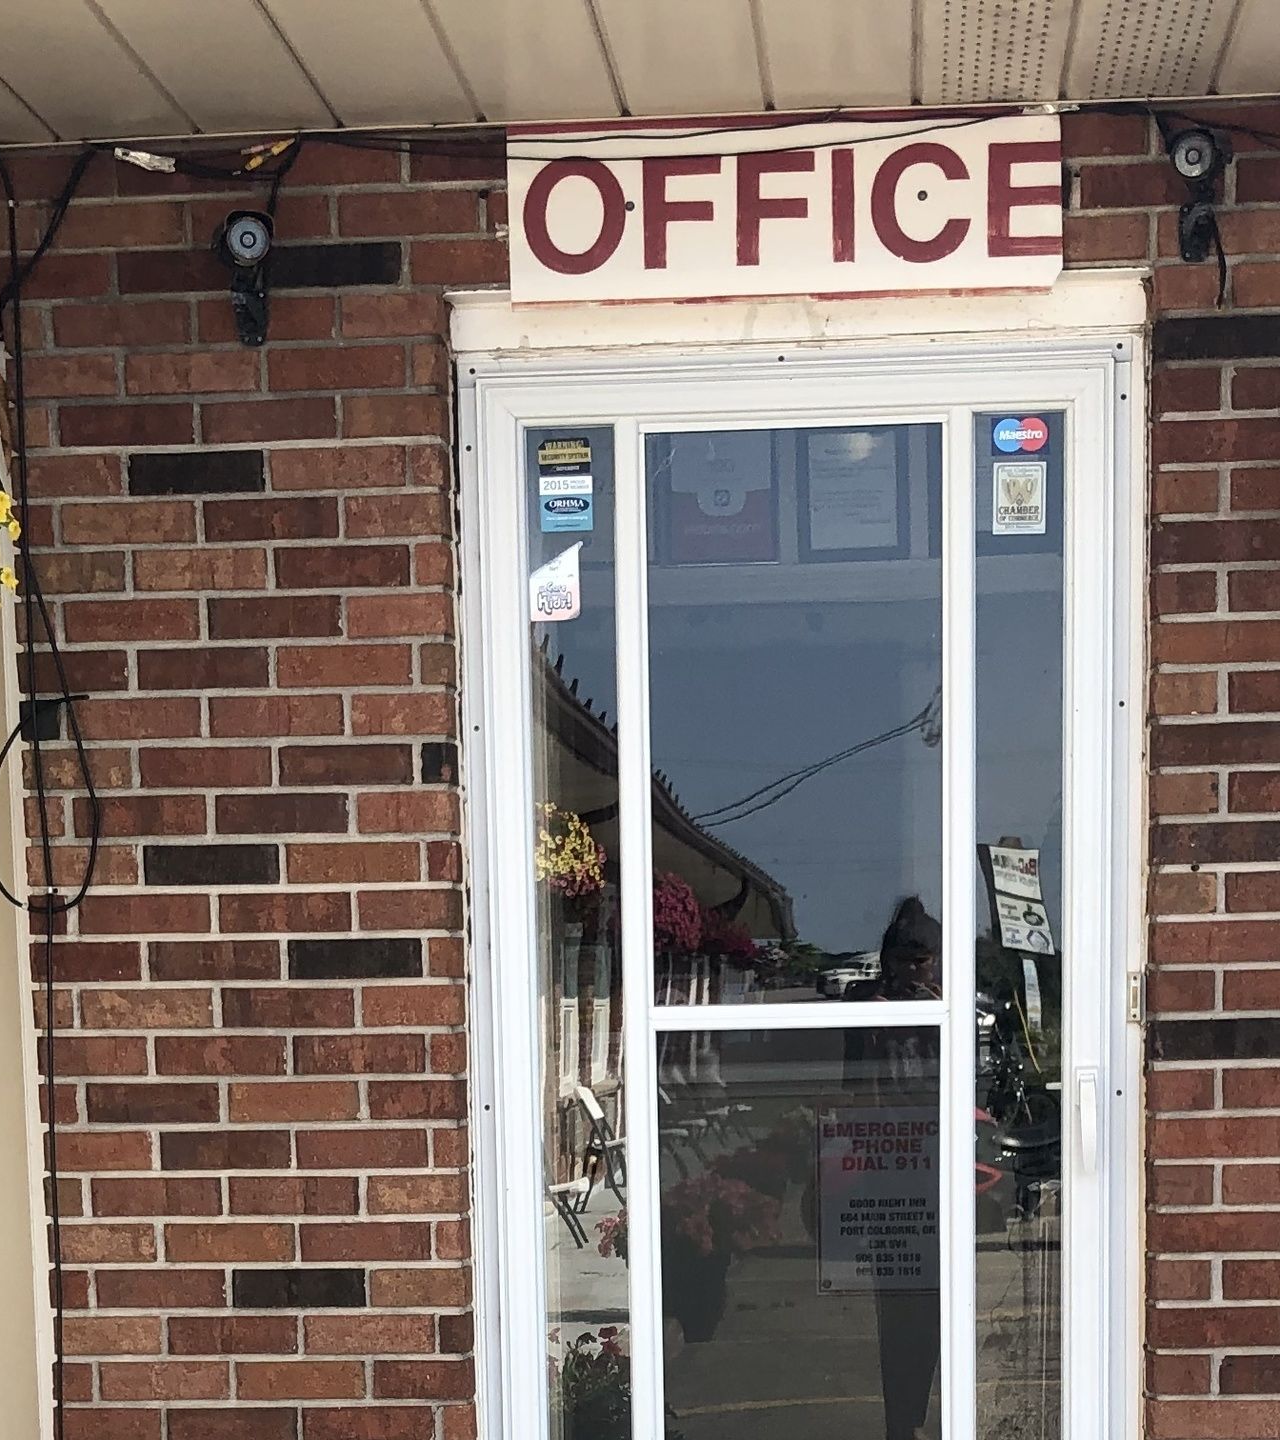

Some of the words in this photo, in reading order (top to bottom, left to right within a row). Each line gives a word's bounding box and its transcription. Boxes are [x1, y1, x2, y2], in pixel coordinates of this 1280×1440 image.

[522, 141, 1063, 275] OFFICE
[998, 429, 1044, 441] Maestro
[543, 480, 570, 491] 2015
[549, 499, 584, 508] ORHMA
[998, 505, 1040, 515] CHAMBER
[823, 1122, 940, 1138] EMERGENC
[851, 1138, 922, 1154] PHONE
[841, 1156, 888, 1171] DIAL
[895, 1155, 931, 1170] 911
[849, 1198, 876, 1208] GOOD
[861, 1212, 886, 1221] MAIN
[888, 1211, 924, 1221] STREET
[840, 1226, 864, 1236] PORT
